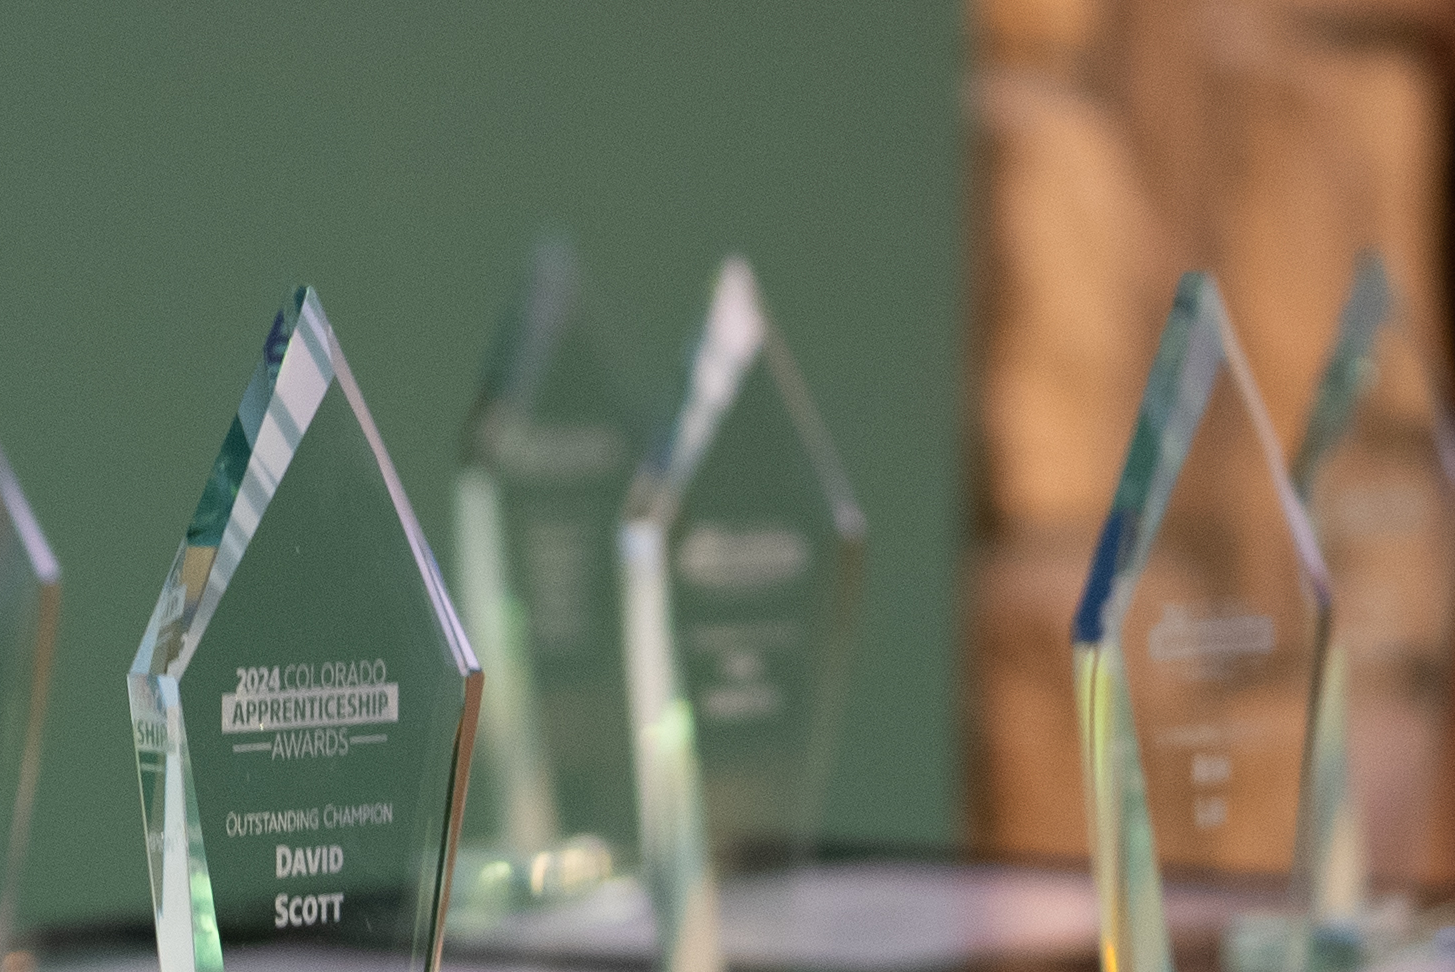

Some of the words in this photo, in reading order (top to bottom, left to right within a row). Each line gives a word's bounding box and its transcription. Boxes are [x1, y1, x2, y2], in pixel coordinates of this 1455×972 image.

[236, 666, 280, 695] 2024
[284, 658, 386, 689] COLORADO
[232, 690, 388, 725] APPRENTICESHIP
[271, 727, 349, 760] AWARDS
[225, 808, 319, 837] OUTSTANDING
[323, 802, 393, 829] CHAMPION
[275, 844, 344, 879] DAVID
[275, 892, 344, 928] SCOTT
